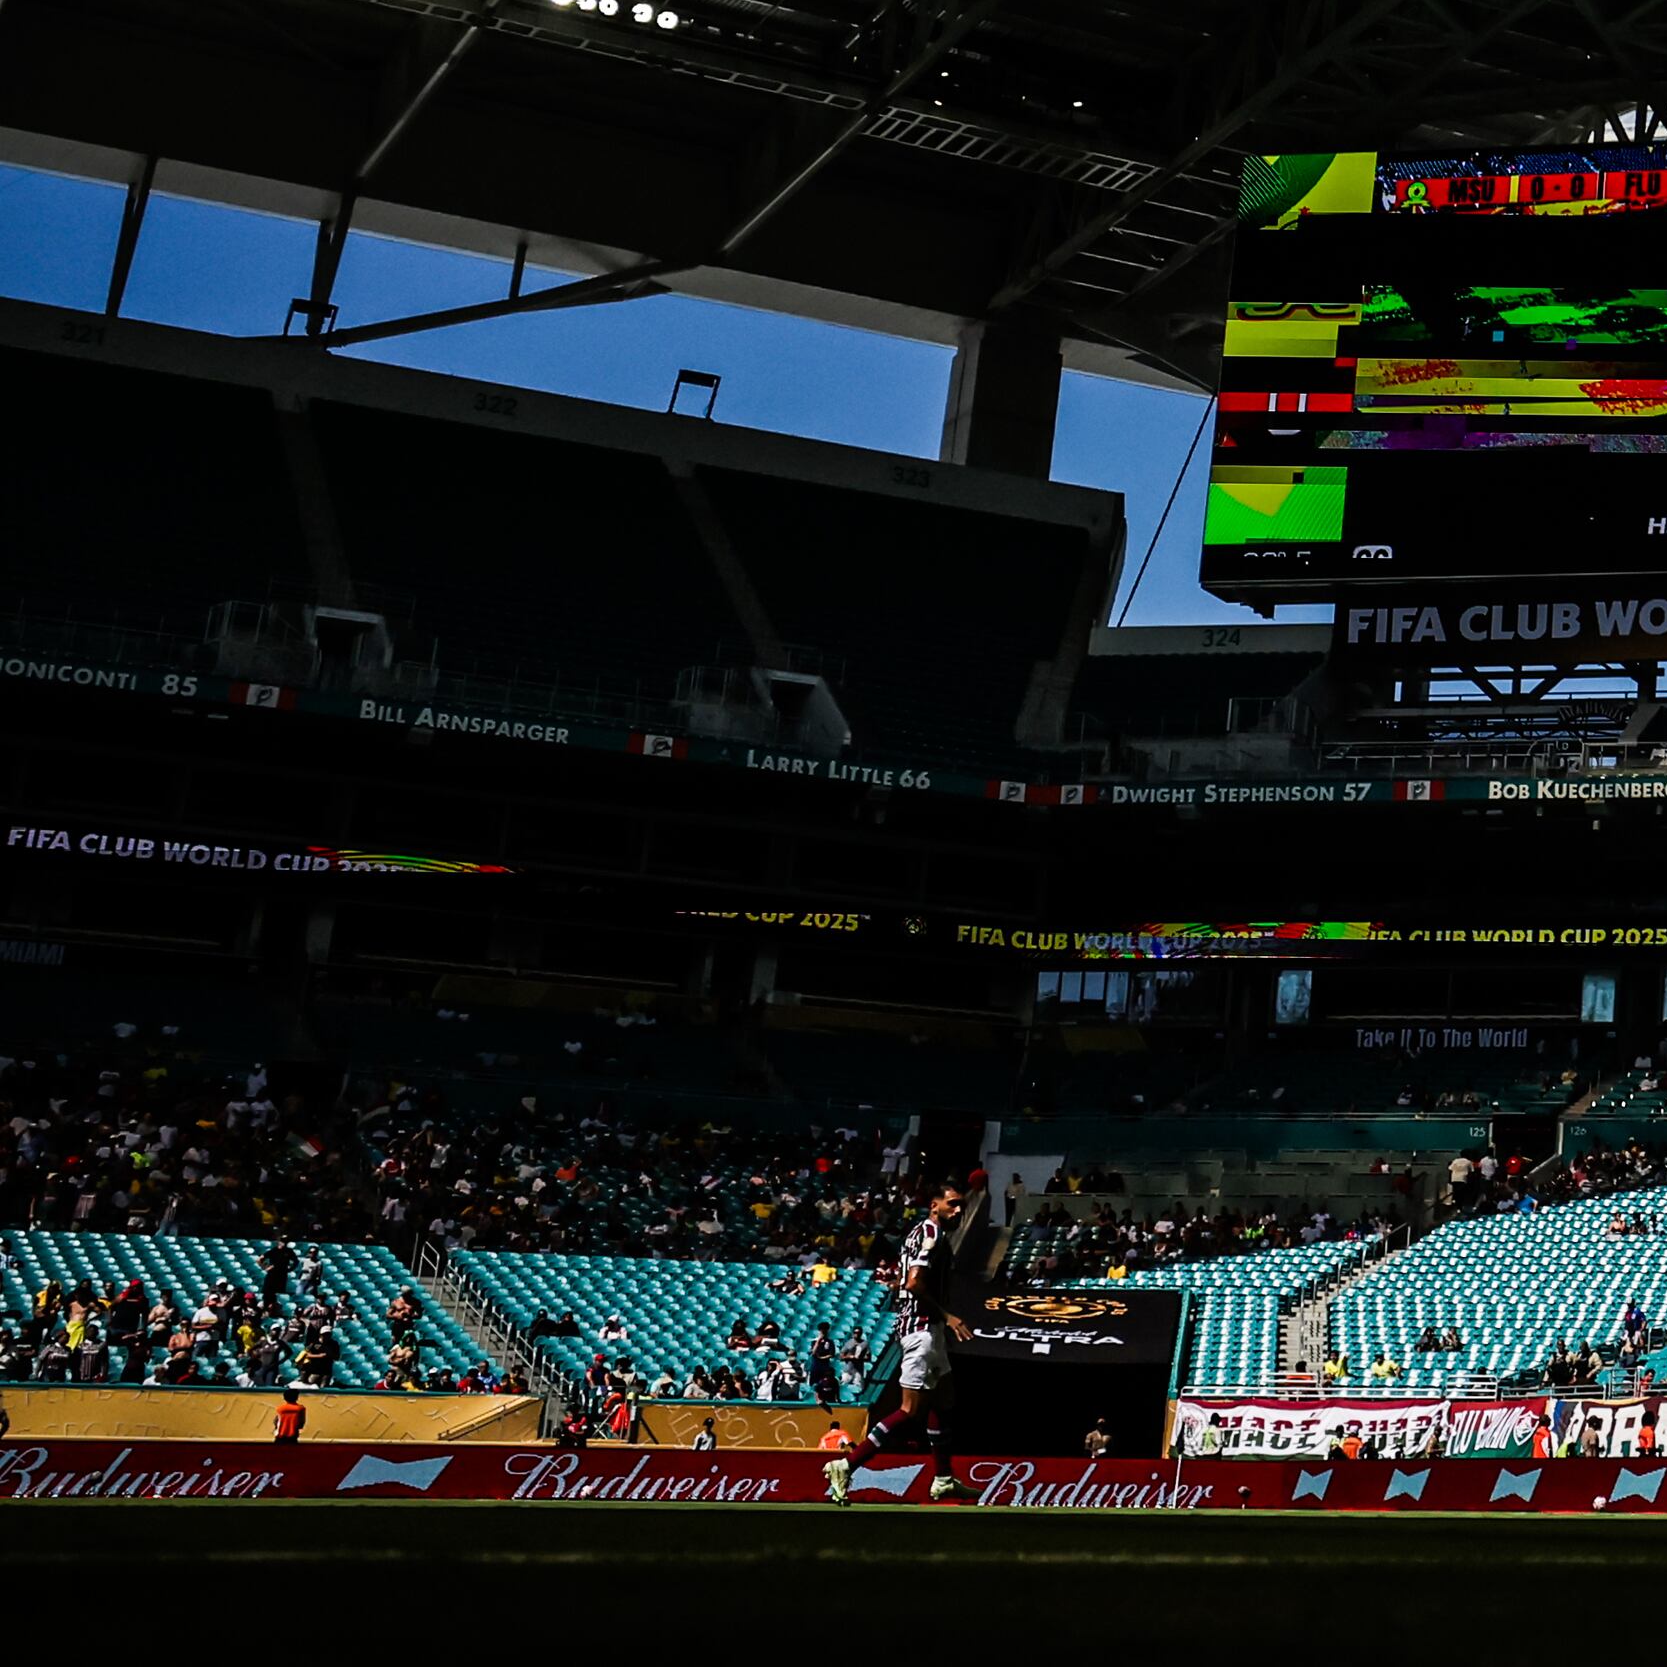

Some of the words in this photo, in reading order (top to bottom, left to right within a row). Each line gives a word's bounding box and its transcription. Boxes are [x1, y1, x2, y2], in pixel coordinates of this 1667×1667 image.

[1448, 177, 1495, 202] MSU
[1531, 177, 1543, 200] 0
[1570, 176, 1584, 198] 0
[1624, 173, 1661, 197] FLU
[62, 320, 106, 345] 321
[474, 394, 517, 416] 322
[893, 466, 930, 488] 323
[1347, 606, 1446, 644] FIFA
[1459, 602, 1581, 641] CLUB
[1203, 629, 1241, 647] 324
[161, 674, 198, 698] 85
[360, 700, 406, 725] BILL
[414, 707, 570, 744] ARNSPARGER
[747, 748, 817, 777] LARRY
[828, 760, 894, 787] LITTLE
[899, 768, 931, 791] 66
[1112, 785, 1196, 805] DWIGHT
[1204, 784, 1335, 804] STEPHENSON
[1343, 782, 1373, 802] 57
[1487, 780, 1530, 801] BOB
[8, 827, 71, 853] FIFA
[80, 831, 155, 861] CLUB
[163, 839, 267, 872] WORLD
[957, 924, 1005, 946] FIFA
[1012, 930, 1068, 951] CLUB
[1560, 927, 1605, 946] CUP
[1442, 1027, 1473, 1049] The
[1476, 1027, 1529, 1050] World
[1469, 1126, 1485, 1138] 125
[973, 1328, 1125, 1345] ULTRA
[0, 1446, 285, 1499] Budweiser
[504, 1452, 784, 1501] Budweiser
[969, 1461, 1217, 1509] Budweiser
